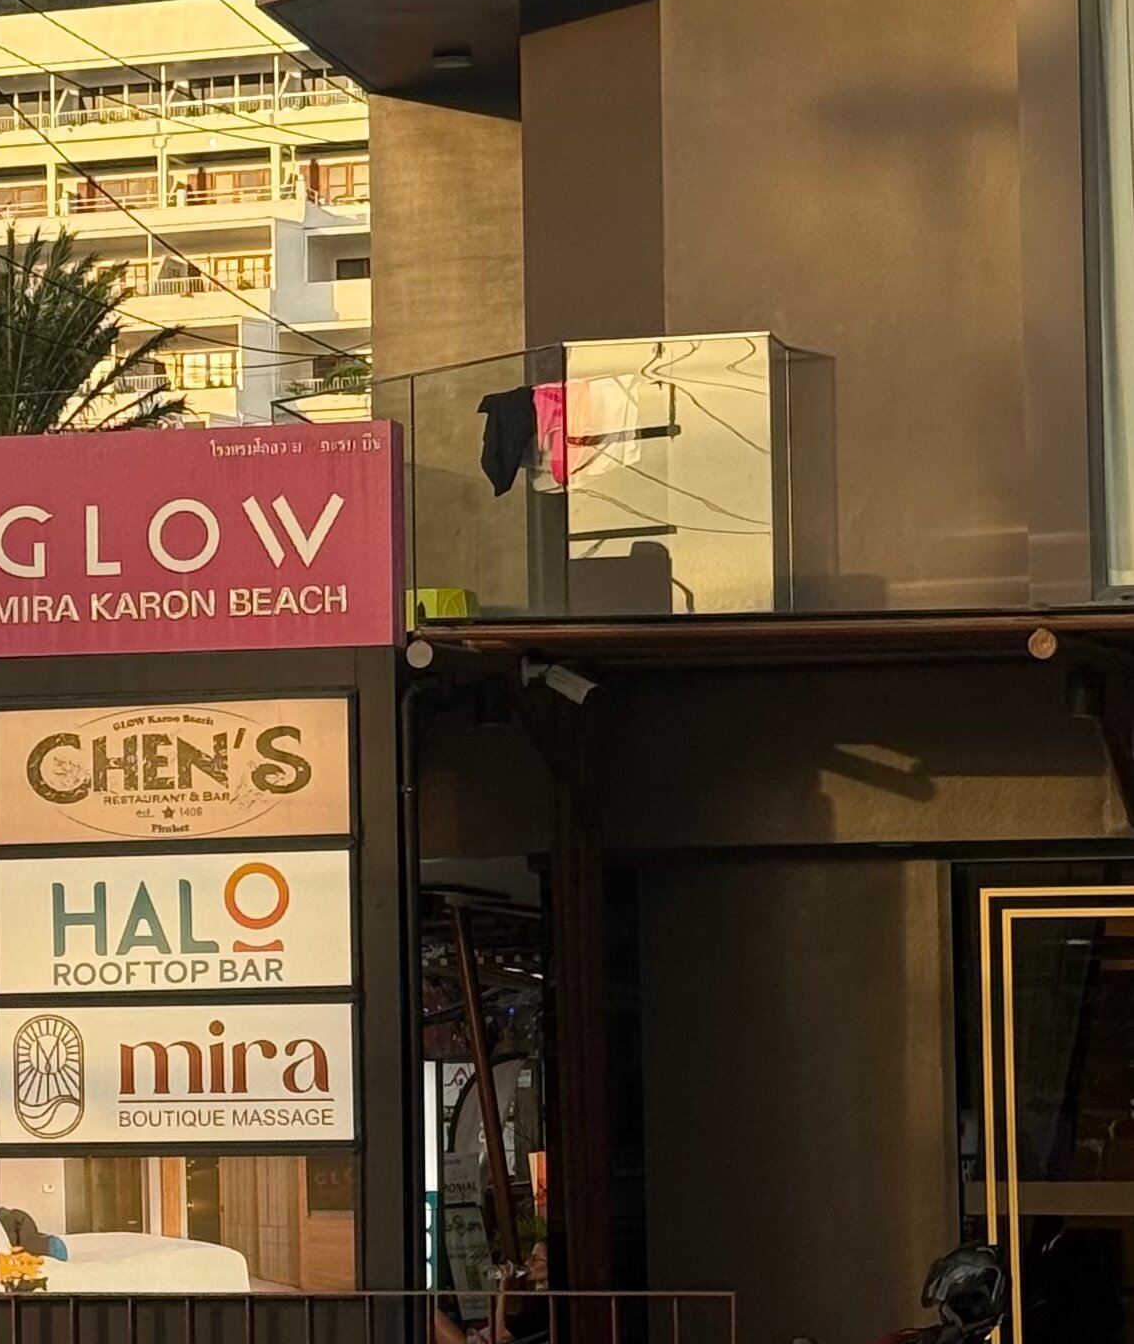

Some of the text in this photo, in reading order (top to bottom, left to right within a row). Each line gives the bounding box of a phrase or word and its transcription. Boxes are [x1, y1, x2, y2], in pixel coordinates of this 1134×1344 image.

[90, 589, 216, 622] KARON
[228, 584, 348, 618] BEACH
[26, 725, 312, 805] CHEN'S
[103, 793, 186, 805] RESTAURANT
[189, 792, 200, 802] &
[52, 862, 290, 957] HALO
[52, 958, 284, 986] ROOFTOP BAR
[119, 1020, 330, 1095] mira
[118, 1109, 334, 1128] BOUTIQUE MASSAGE
